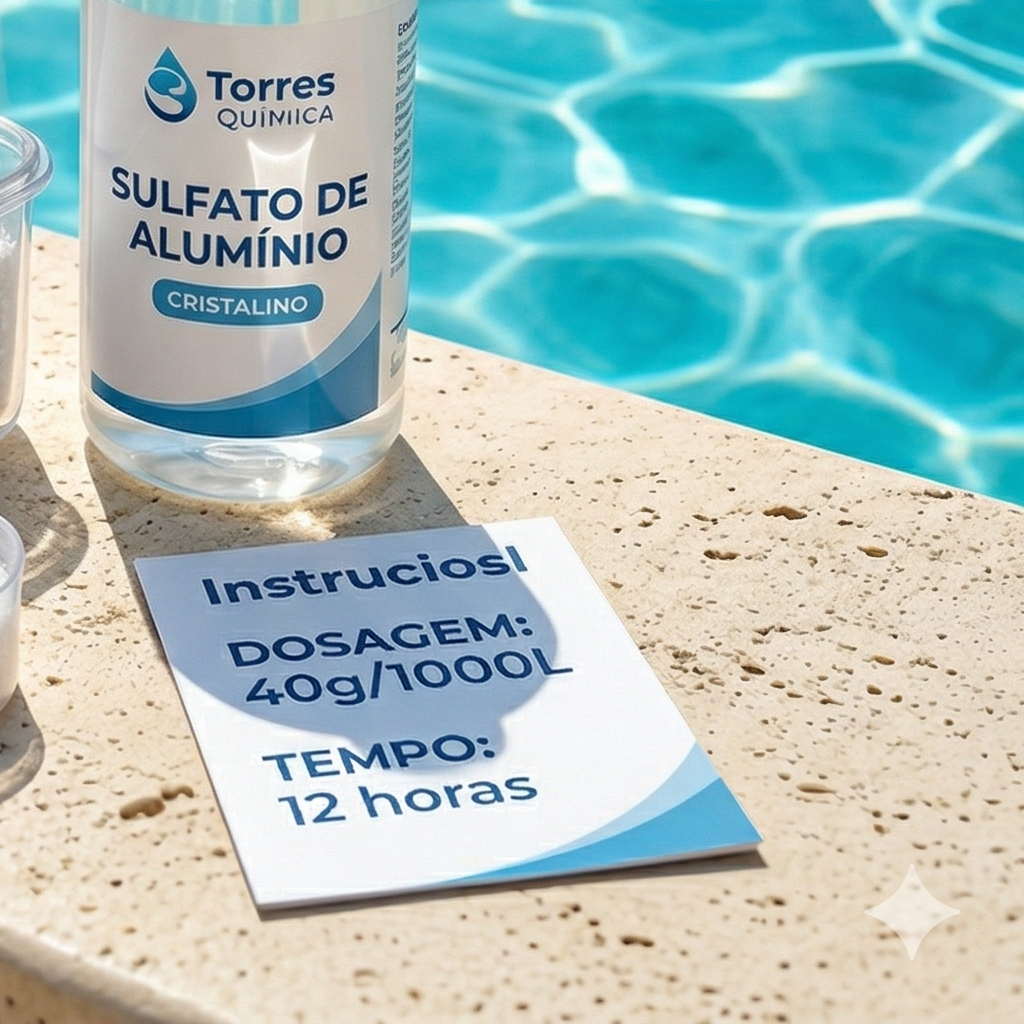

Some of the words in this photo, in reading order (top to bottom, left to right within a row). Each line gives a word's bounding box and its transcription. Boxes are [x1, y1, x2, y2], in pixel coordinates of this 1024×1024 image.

[206, 70, 336, 102] Torres
[111, 165, 304, 223] SULFATO
[317, 173, 369, 217] DE
[129, 220, 349, 269] ALUMÍNIO
[166, 290, 309, 316] CRISTALINO
[227, 612, 534, 667] DOSAGEM:
[245, 647, 574, 706] 40g/1000L
[260, 734, 496, 783] TEMPO:
[278, 792, 347, 827] 12
[357, 776, 539, 819] horas
